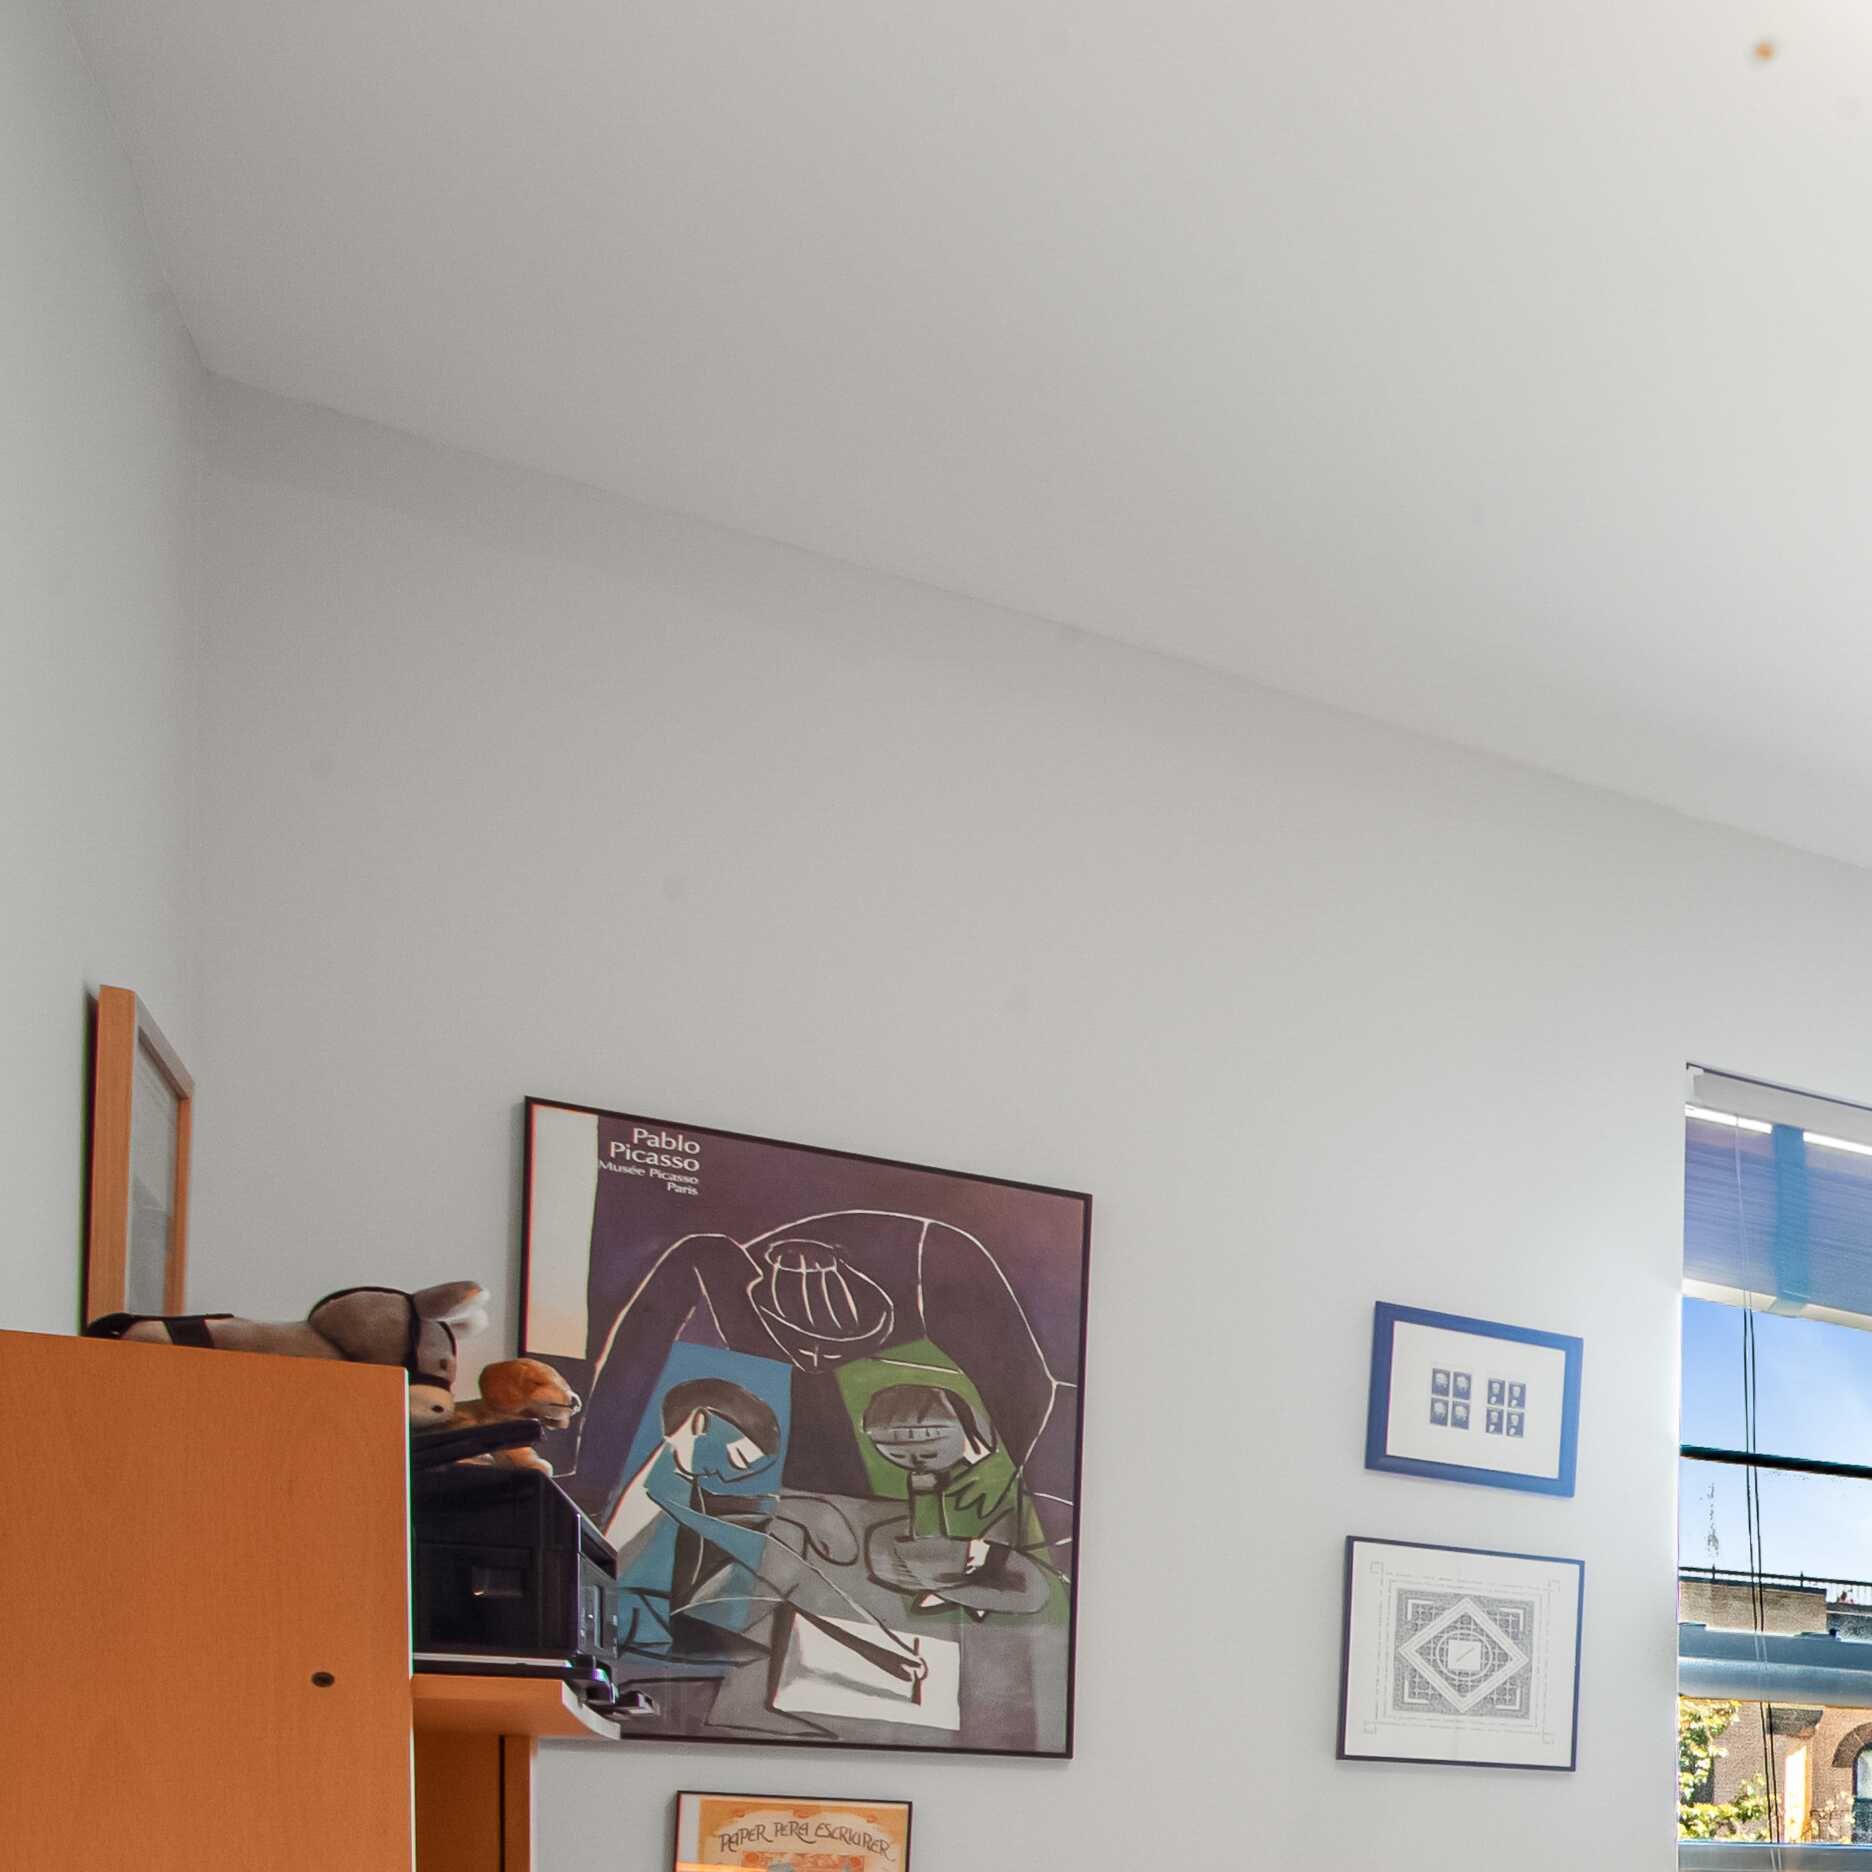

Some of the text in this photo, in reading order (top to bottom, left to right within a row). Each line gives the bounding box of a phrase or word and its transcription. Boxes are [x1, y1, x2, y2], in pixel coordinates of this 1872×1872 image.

[633, 1127, 700, 1154] Pablo
[610, 1141, 700, 1171] Picasso
[600, 1160, 699, 1184] Musée Picasso
[667, 1182, 698, 1195] Paris
[720, 1824, 774, 1853] PAPER
